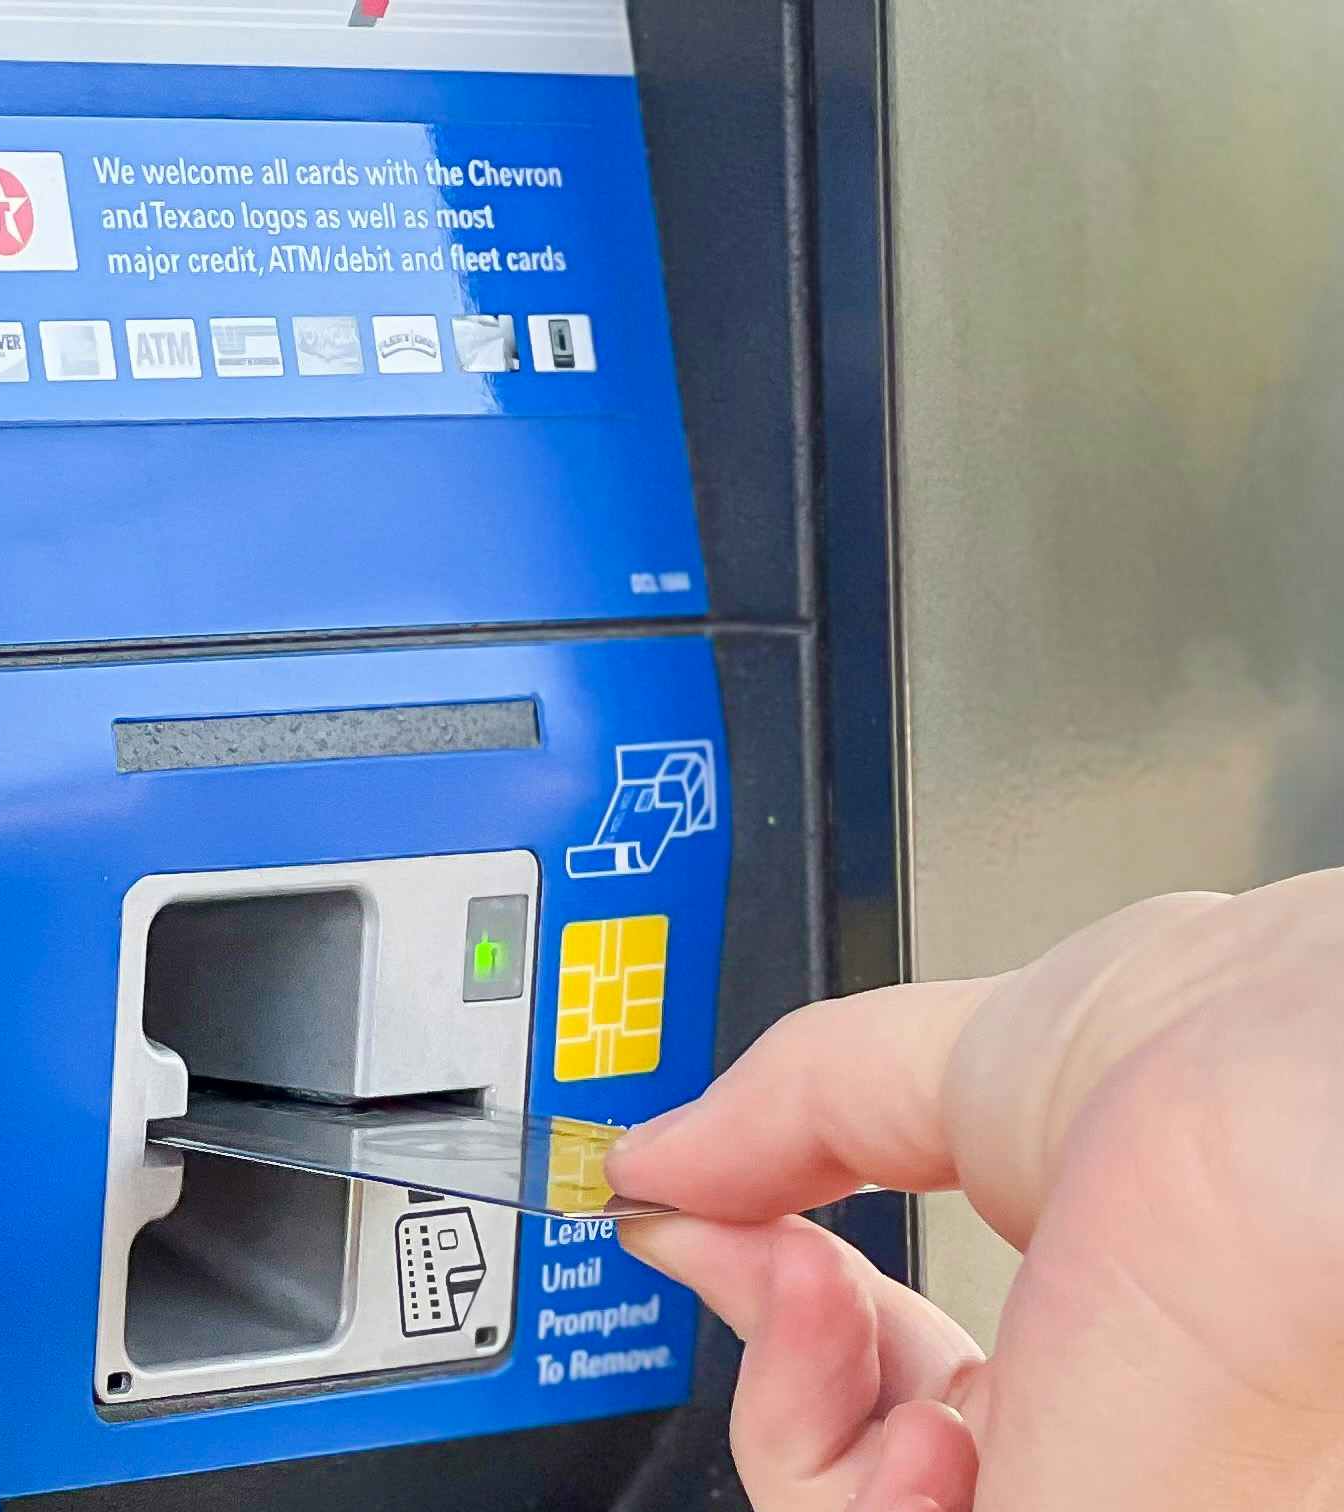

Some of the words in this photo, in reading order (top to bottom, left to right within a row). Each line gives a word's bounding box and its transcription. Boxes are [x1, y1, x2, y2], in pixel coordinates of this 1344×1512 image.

[93, 157, 135, 185] We
[142, 157, 253, 186] welcome
[262, 158, 288, 185] all
[296, 158, 359, 187] cards
[365, 159, 419, 187] with
[425, 159, 464, 187] the
[468, 160, 563, 189] Chevron
[102, 202, 149, 229] and
[150, 201, 235, 229] Texaco
[241, 201, 308, 236] logos
[315, 208, 341, 229] as
[347, 202, 396, 229] well
[404, 208, 429, 229] as
[436, 203, 495, 230] most
[108, 247, 180, 281] major
[188, 246, 264, 278] credit,
[269, 244, 393, 274] ATM/debit
[401, 246, 445, 273] and
[451, 245, 501, 273] fleet
[507, 245, 567, 273] cards
[136, 331, 194, 367] ATM
[544, 1218, 614, 1247] Leave
[542, 1257, 601, 1293] Until
[537, 1293, 660, 1340] Prompted
[536, 1353, 564, 1386] To
